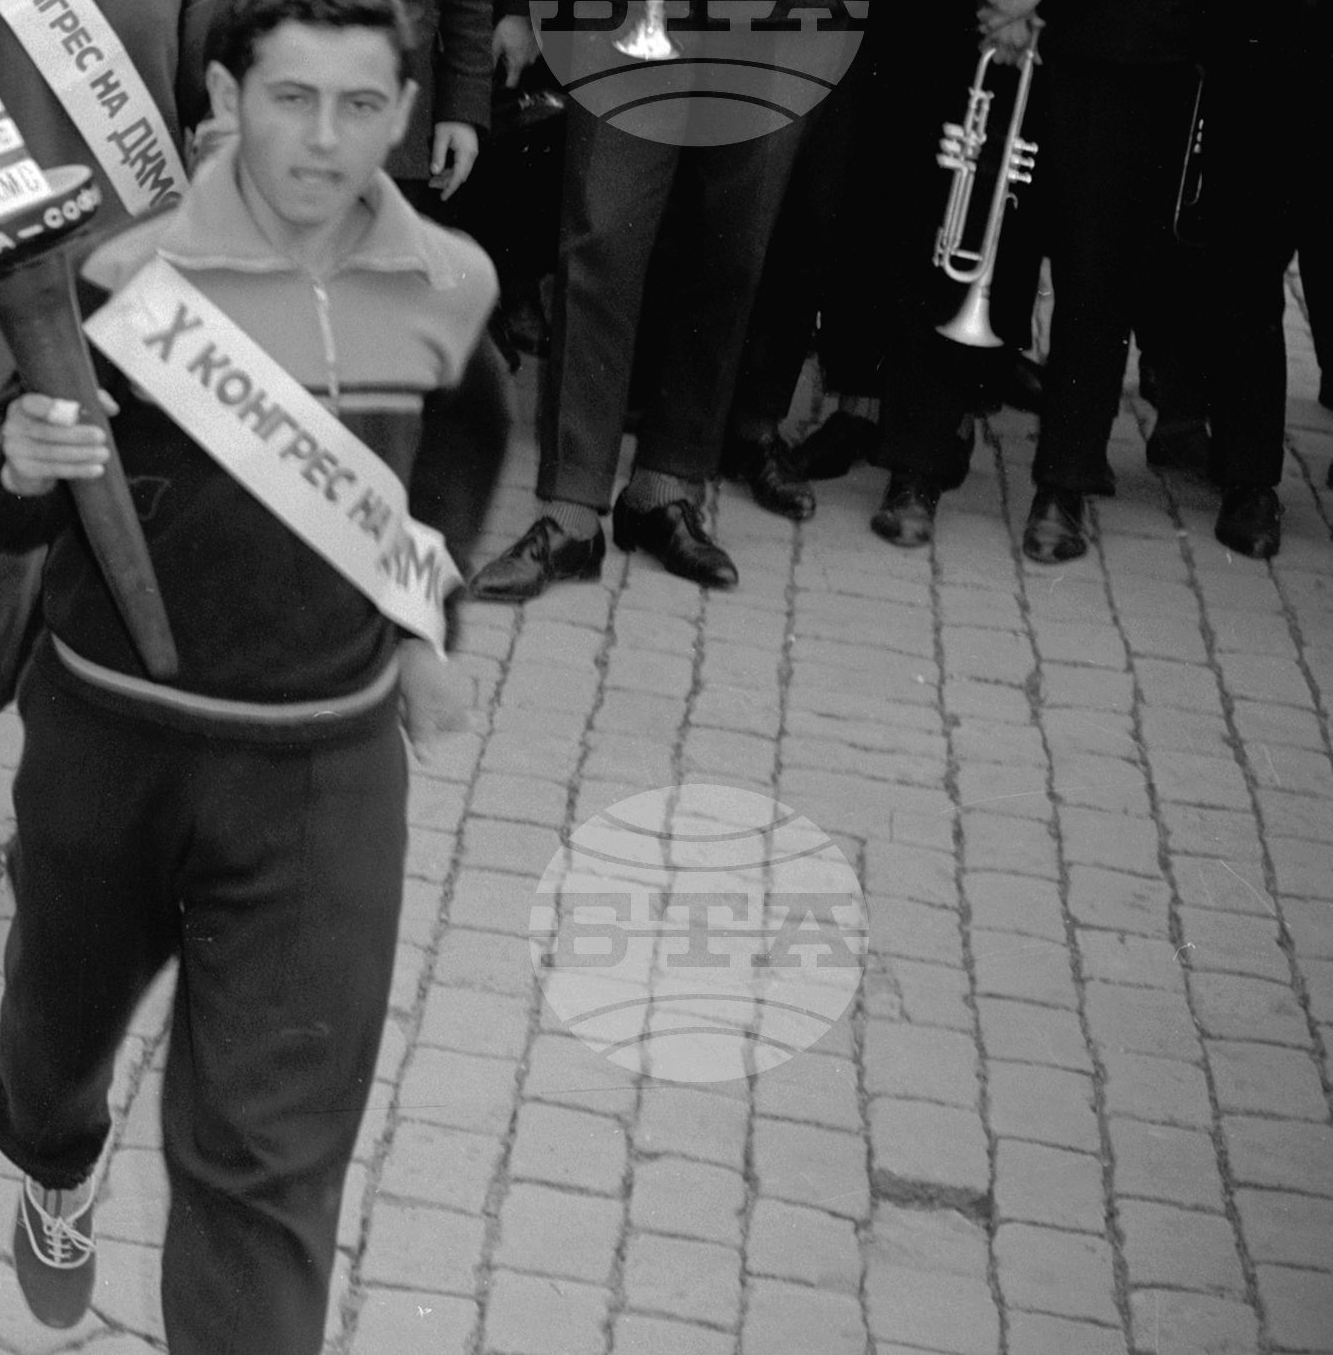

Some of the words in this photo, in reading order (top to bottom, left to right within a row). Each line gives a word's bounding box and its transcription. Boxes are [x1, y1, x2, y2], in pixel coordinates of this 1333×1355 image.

[89, 68, 130, 120] НА
[143, 300, 204, 363] X
[185, 339, 358, 503] КОНГРЕС
[345, 486, 393, 544] НА
